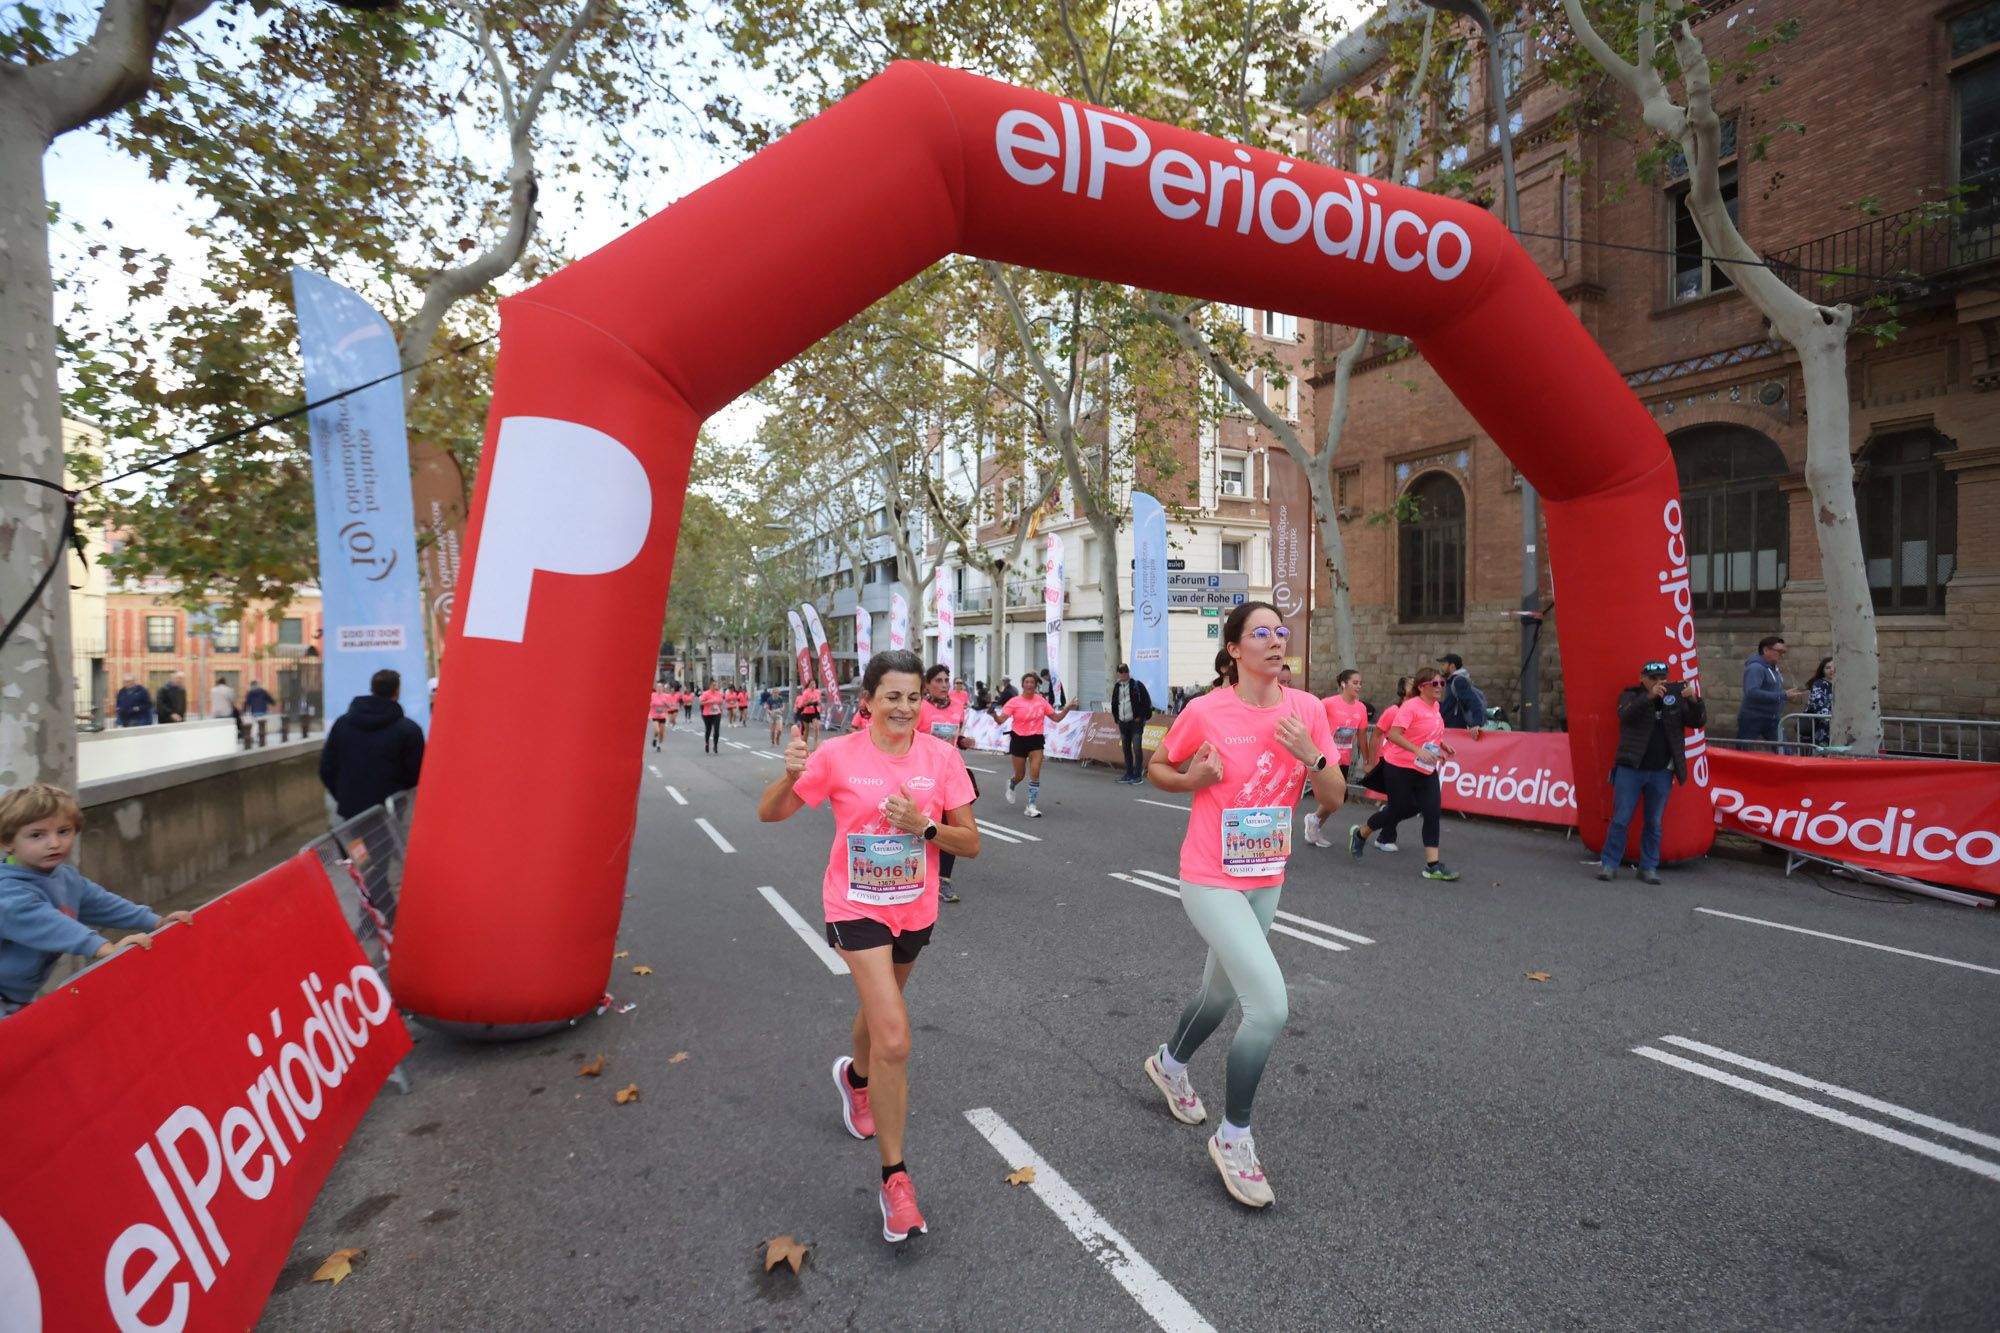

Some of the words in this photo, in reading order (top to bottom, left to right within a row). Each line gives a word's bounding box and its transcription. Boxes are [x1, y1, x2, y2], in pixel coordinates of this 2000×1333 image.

[995, 102, 1472, 281] elPeriódico
[463, 415, 653, 643] P
[1190, 594, 1204, 602] der
[1208, 594, 1230, 603] Rohe
[1659, 499, 1709, 787] elriódico
[848, 776, 884, 786] OYSHO
[873, 866, 902, 878] 016
[1246, 838, 1271, 849] 016
[104, 965, 393, 1333] elPeriódico
